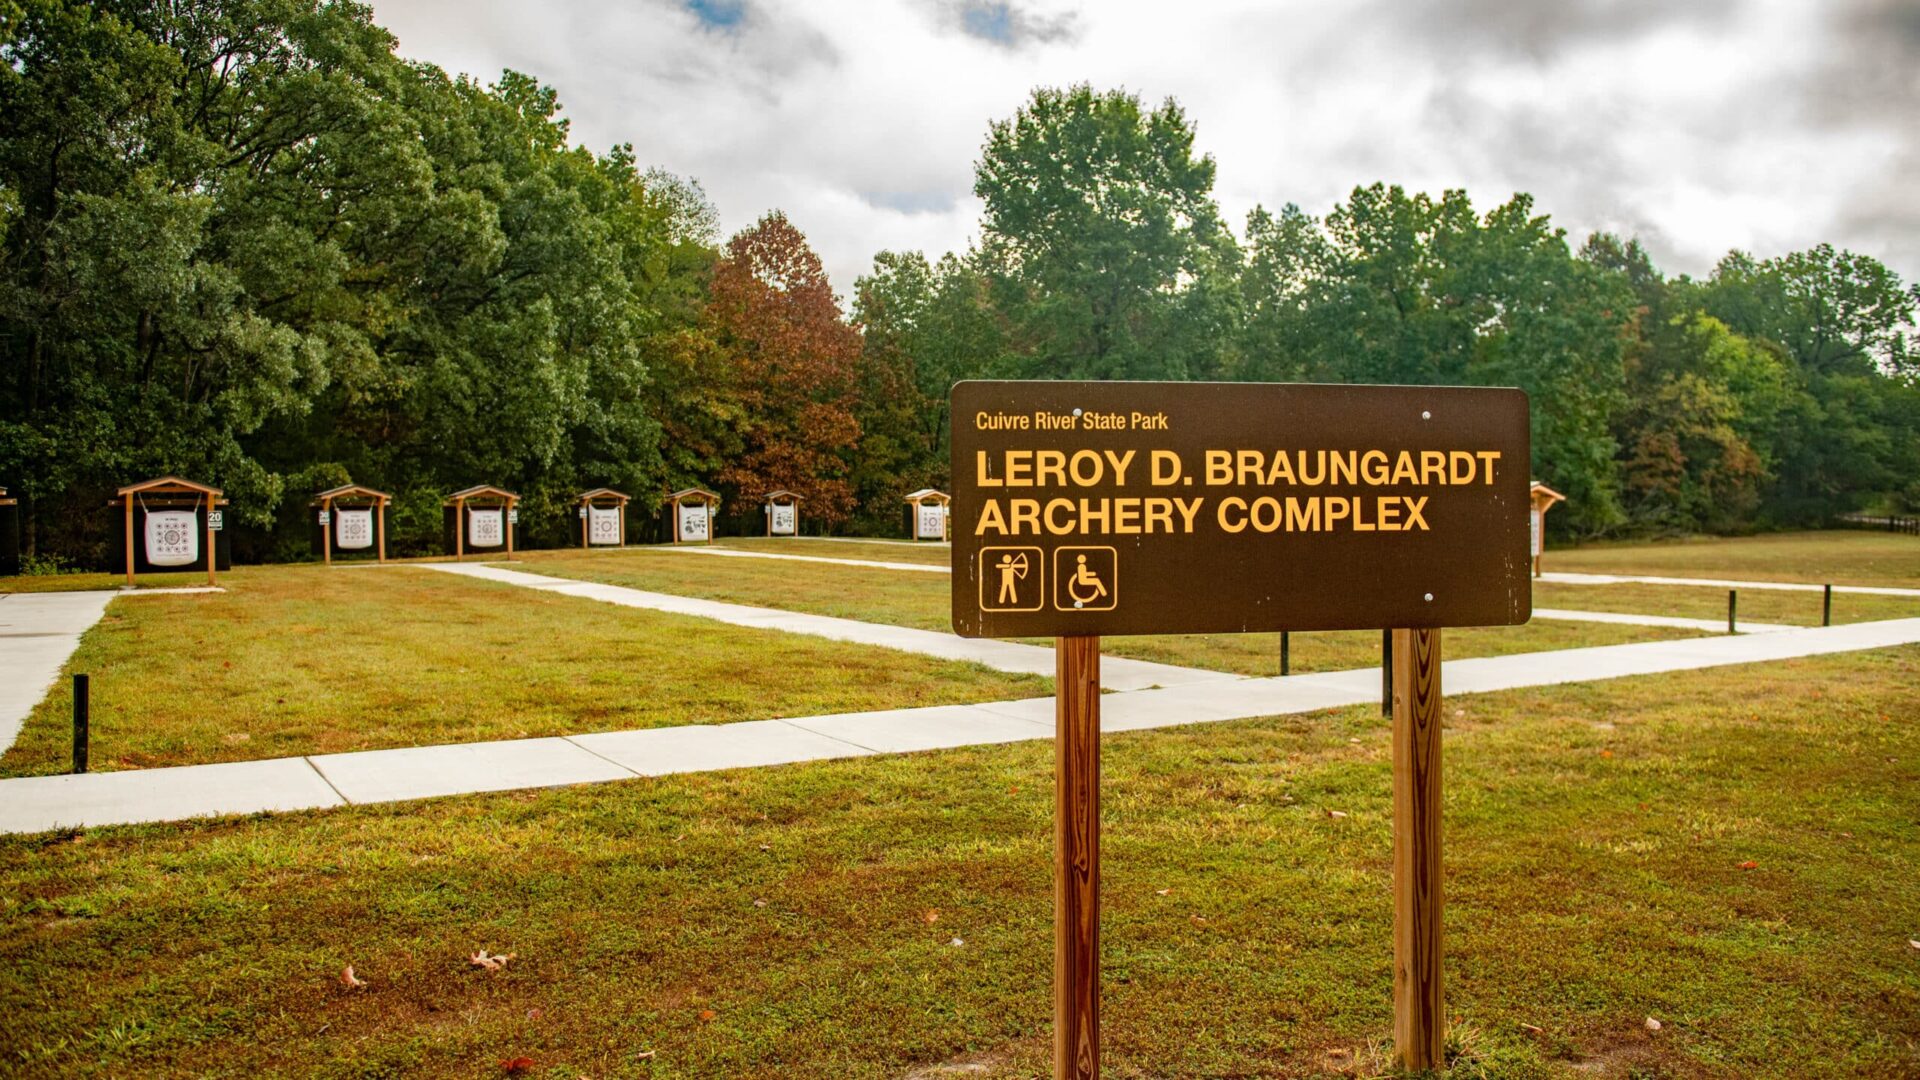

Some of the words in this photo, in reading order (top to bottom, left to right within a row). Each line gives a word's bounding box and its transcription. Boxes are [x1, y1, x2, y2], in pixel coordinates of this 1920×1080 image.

[976, 411, 1030, 430] Cuivre
[1035, 411, 1077, 430] River
[1082, 411, 1126, 430] State
[1131, 411, 1168, 430] Park
[976, 449, 1136, 487] LEROY
[1151, 449, 1193, 486] D.
[1205, 449, 1502, 486] BRAUNGARDT
[208, 512, 221, 521] 20
[974, 497, 1204, 536] ARCHERY
[1217, 495, 1431, 533] COMPLEX
